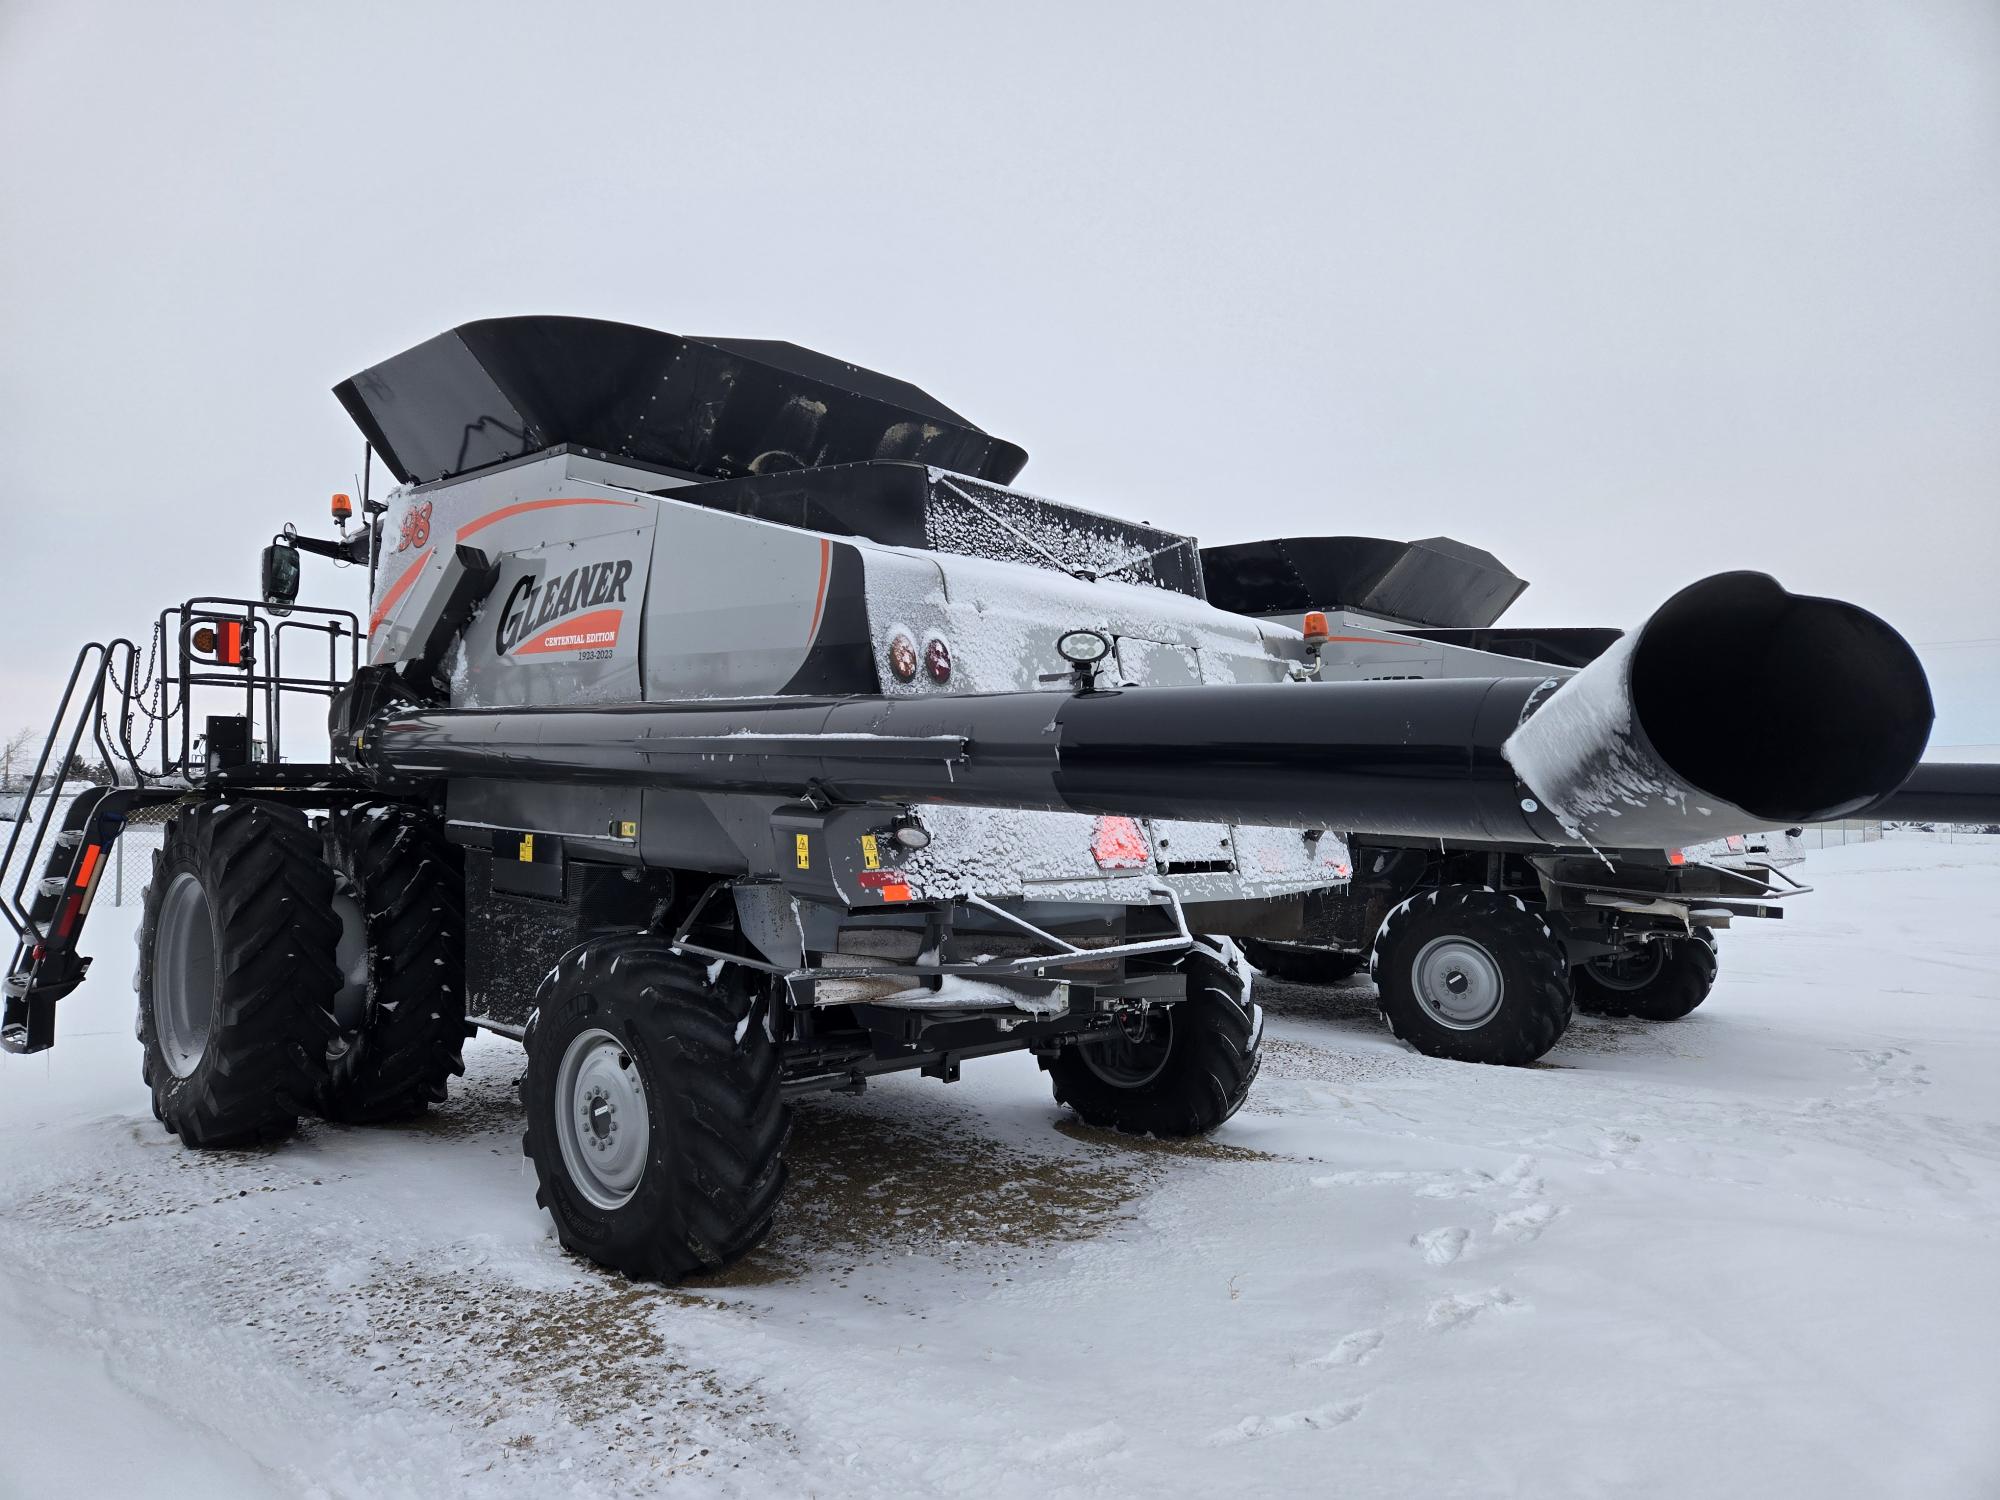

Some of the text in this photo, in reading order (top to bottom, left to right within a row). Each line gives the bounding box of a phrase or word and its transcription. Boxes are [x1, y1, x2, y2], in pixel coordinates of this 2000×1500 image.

[496, 560, 632, 656] GLEANER
[544, 631, 615, 647] CENTENNIAL EDITION
[578, 649, 613, 660] 1923-2023
